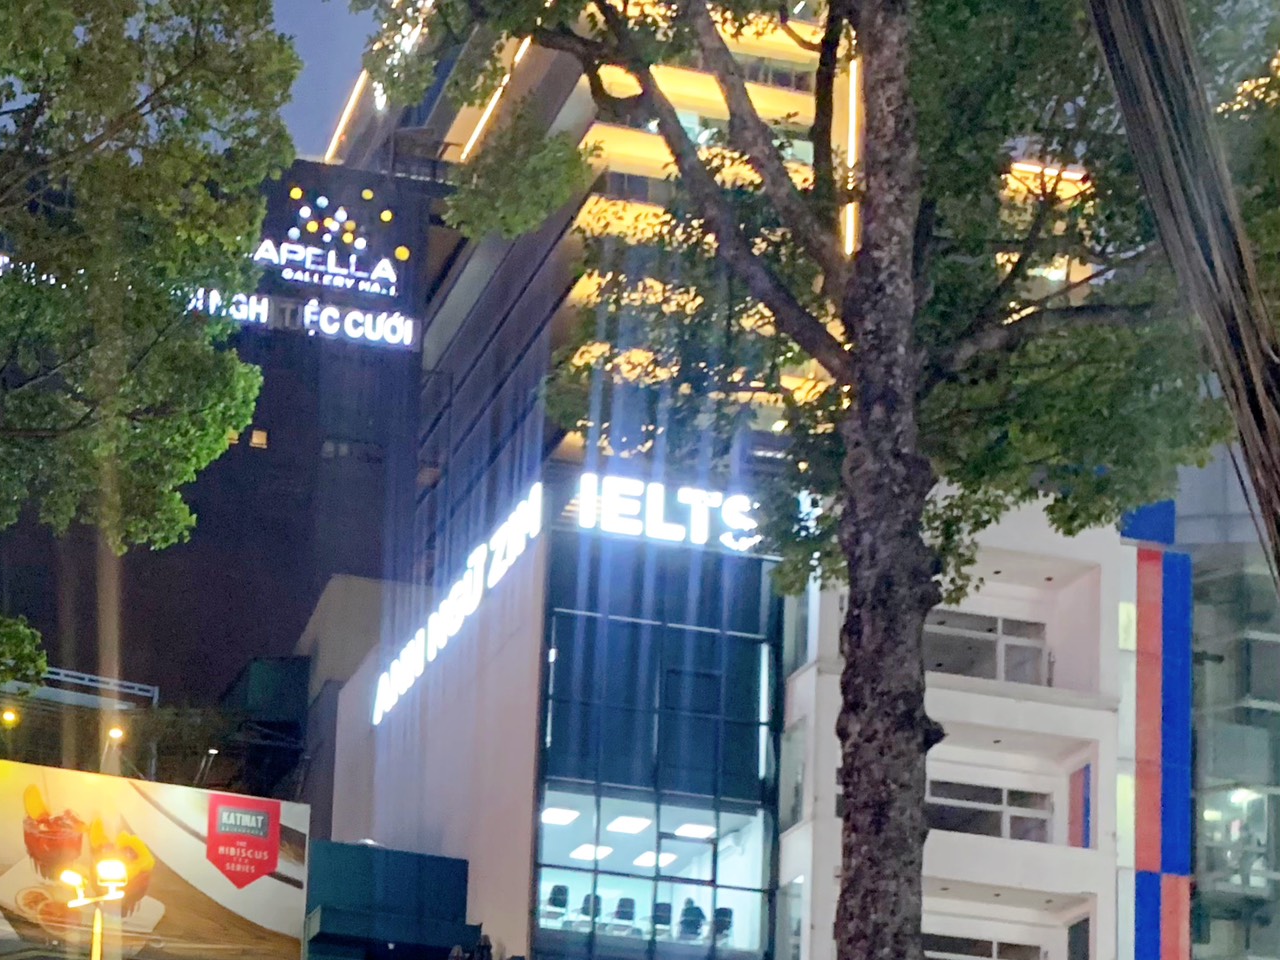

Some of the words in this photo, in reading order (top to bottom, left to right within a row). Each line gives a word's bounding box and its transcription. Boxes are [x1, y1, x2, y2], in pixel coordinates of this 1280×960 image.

[246, 239, 398, 284] APELLA
[578, 472, 762, 551] IELTS
[221, 811, 264, 828] KATINAT
[218, 846, 269, 861] HIBISCUS
[225, 862, 256, 873] SERIES
